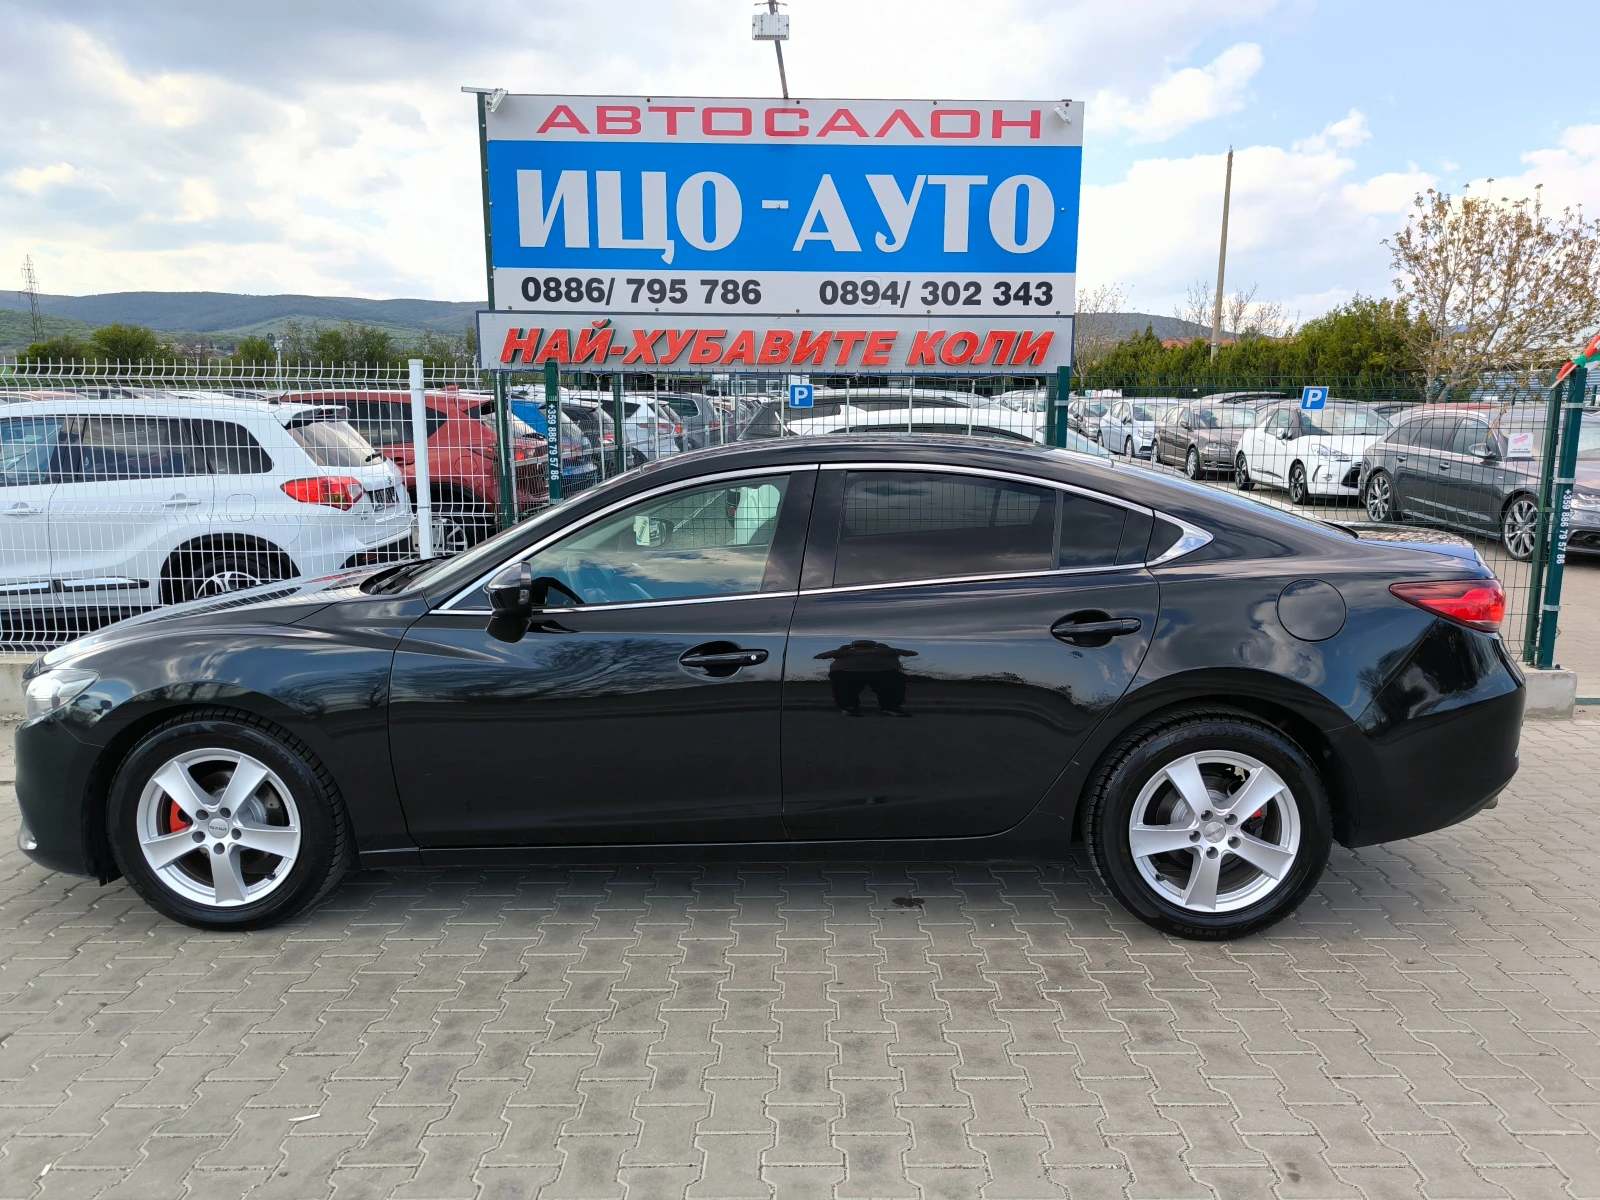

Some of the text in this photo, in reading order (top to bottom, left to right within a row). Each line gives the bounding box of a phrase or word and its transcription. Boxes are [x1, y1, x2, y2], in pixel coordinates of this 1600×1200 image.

[535, 104, 1042, 139] АВТОСАЛОН
[516, 169, 743, 265] ИЦО
[521, 276, 762, 306] 0886/ 795 786
[819, 280, 1054, 308] 0894/ 302 343
[499, 318, 1055, 366] НАЙ-ХУБАВИТЕ КОЛИ
[794, 387, 808, 405] P
[1305, 389, 1322, 408] P
[547, 403, 560, 480] +359 886 79 57 86
[1555, 489, 1572, 564] +359 886 79 57 86
